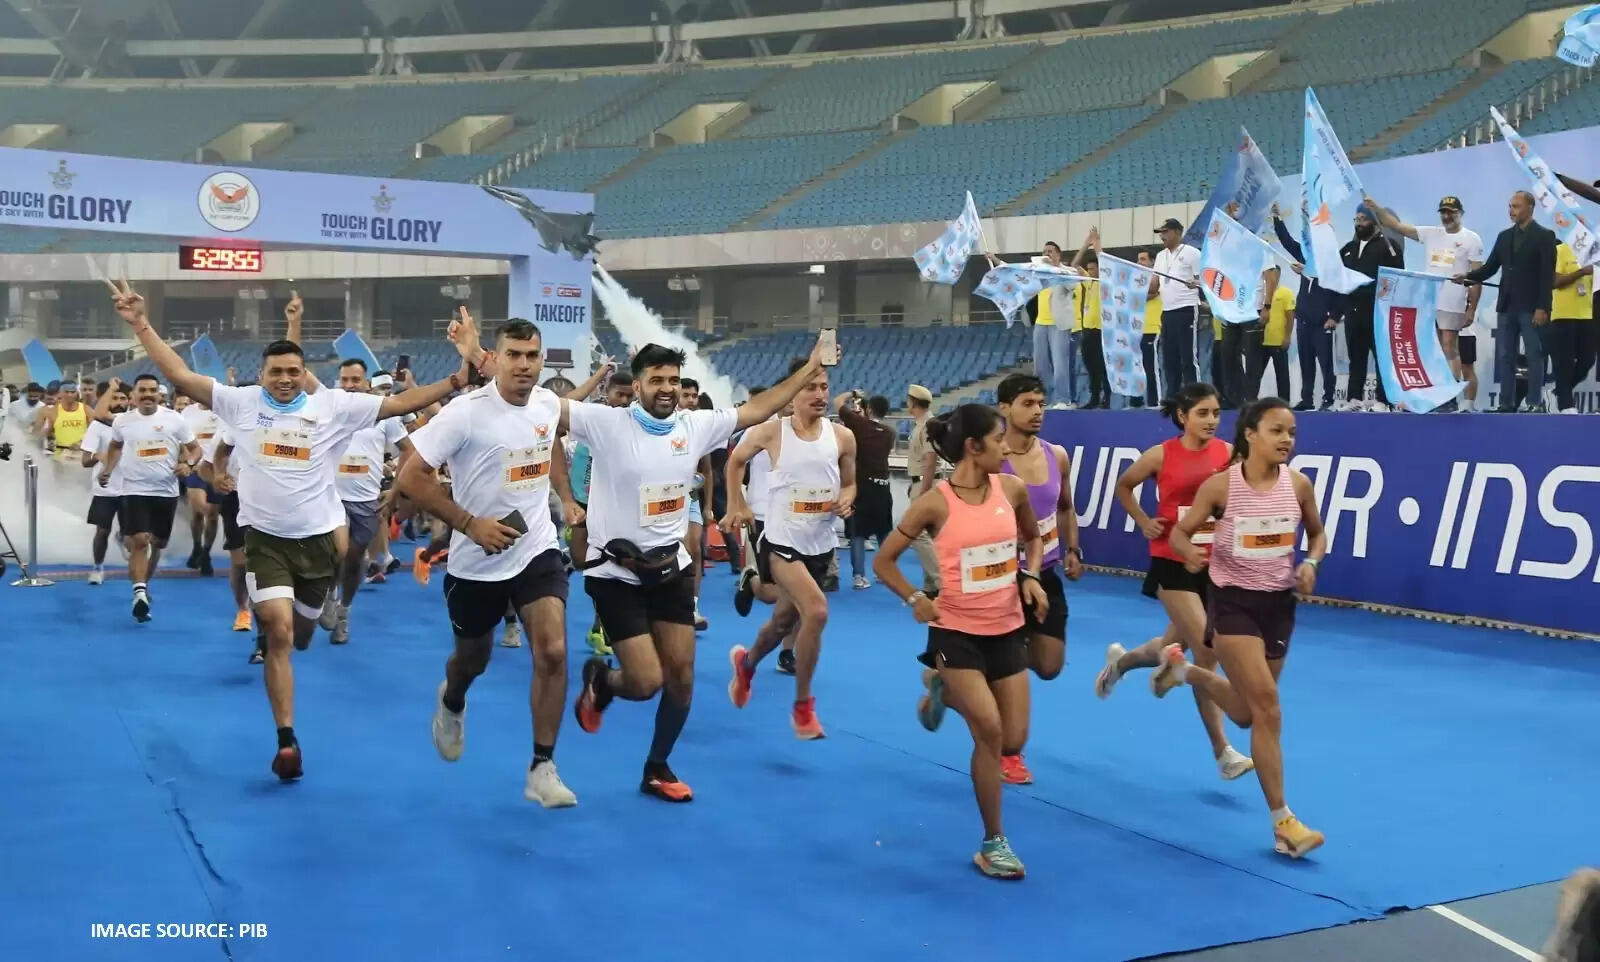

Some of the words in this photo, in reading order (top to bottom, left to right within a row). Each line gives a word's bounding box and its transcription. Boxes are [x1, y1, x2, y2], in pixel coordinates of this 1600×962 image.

[0, 190, 44, 208] OUCH
[48, 194, 132, 224] GLORY
[23, 209, 44, 218] WITH
[321, 213, 368, 230] TOUCH
[371, 217, 442, 243] GLORY
[534, 303, 586, 324] TAKEOFF
[1393, 311, 1403, 340] FIRST
[1395, 342, 1407, 365] IDFC
[1404, 341, 1416, 364] Bank
[1069, 445, 1145, 533] UN
[1429, 461, 1600, 584] INS
